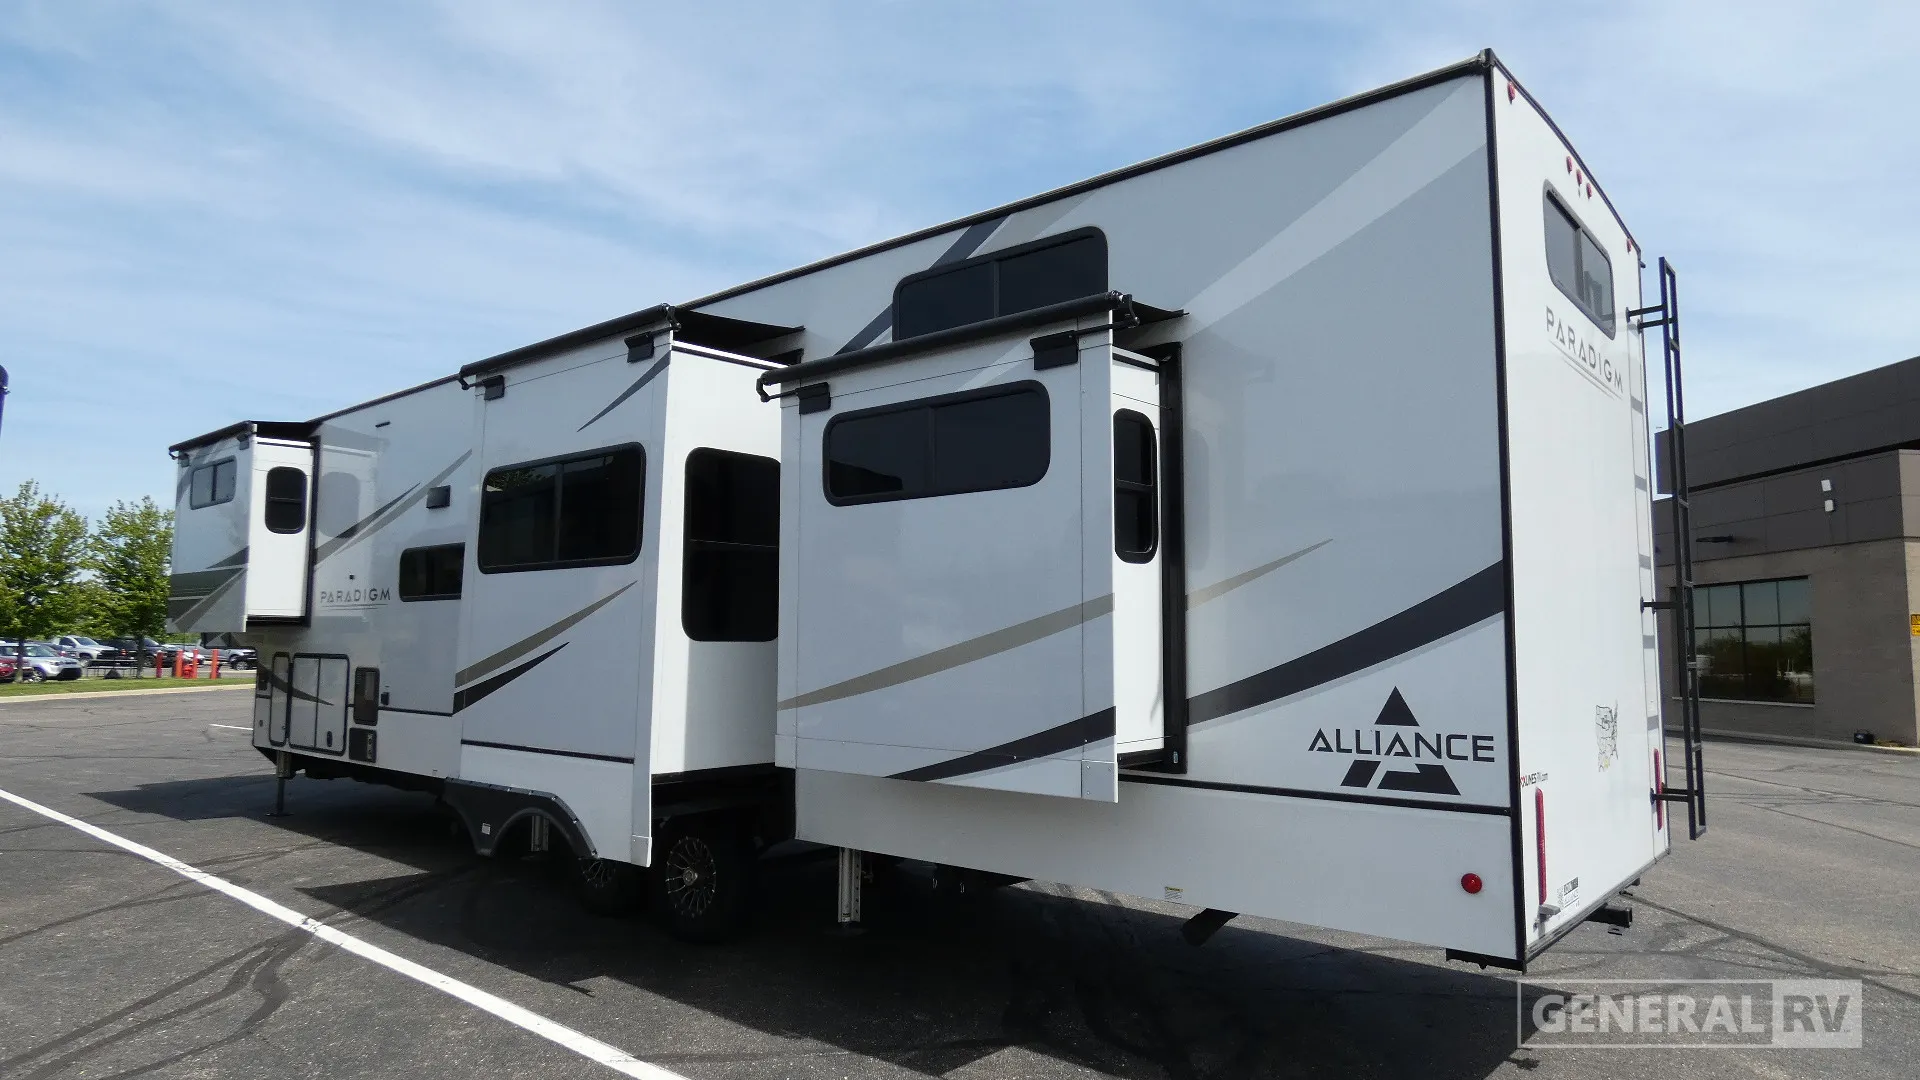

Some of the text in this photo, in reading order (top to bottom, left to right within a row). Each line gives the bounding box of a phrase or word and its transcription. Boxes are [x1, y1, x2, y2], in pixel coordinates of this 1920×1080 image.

[1546, 300, 1623, 394] PARADIGM
[320, 587, 391, 603] PARADIGM
[1308, 728, 1495, 762] ALLIANCE
